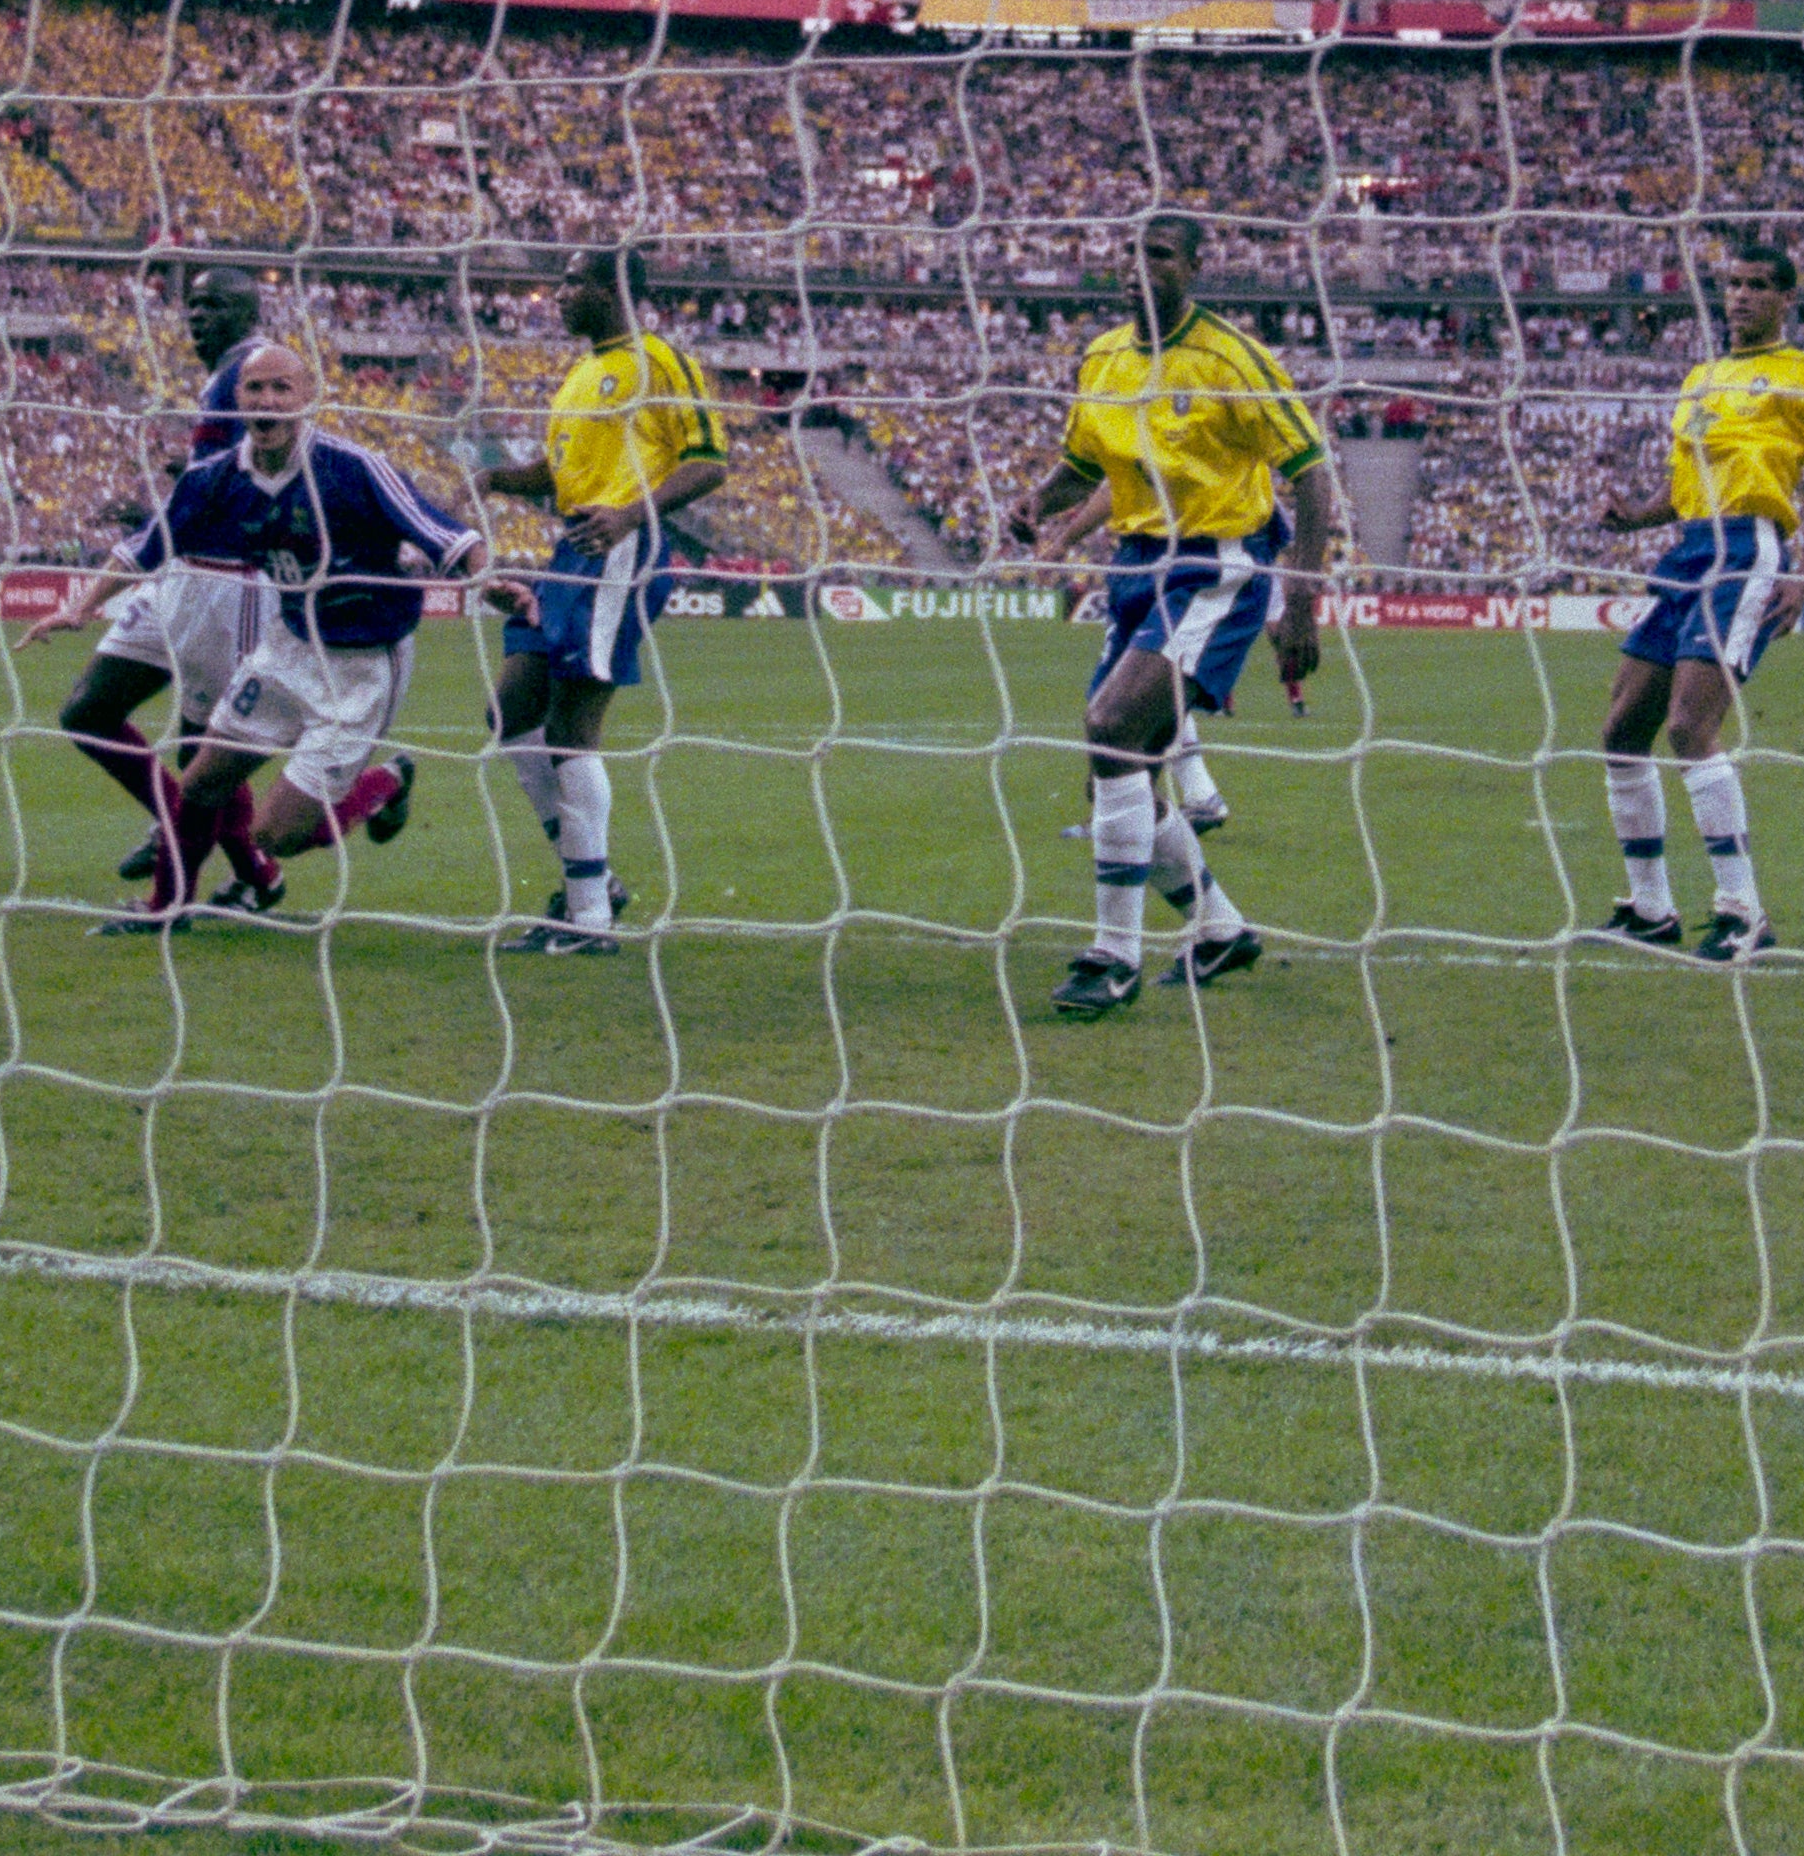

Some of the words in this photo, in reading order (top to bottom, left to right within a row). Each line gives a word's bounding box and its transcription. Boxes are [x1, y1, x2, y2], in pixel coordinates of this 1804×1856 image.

[891, 590, 1056, 619] FUJIFILM
[1317, 596, 1379, 626] JVC
[1473, 597, 1547, 628] JVC
